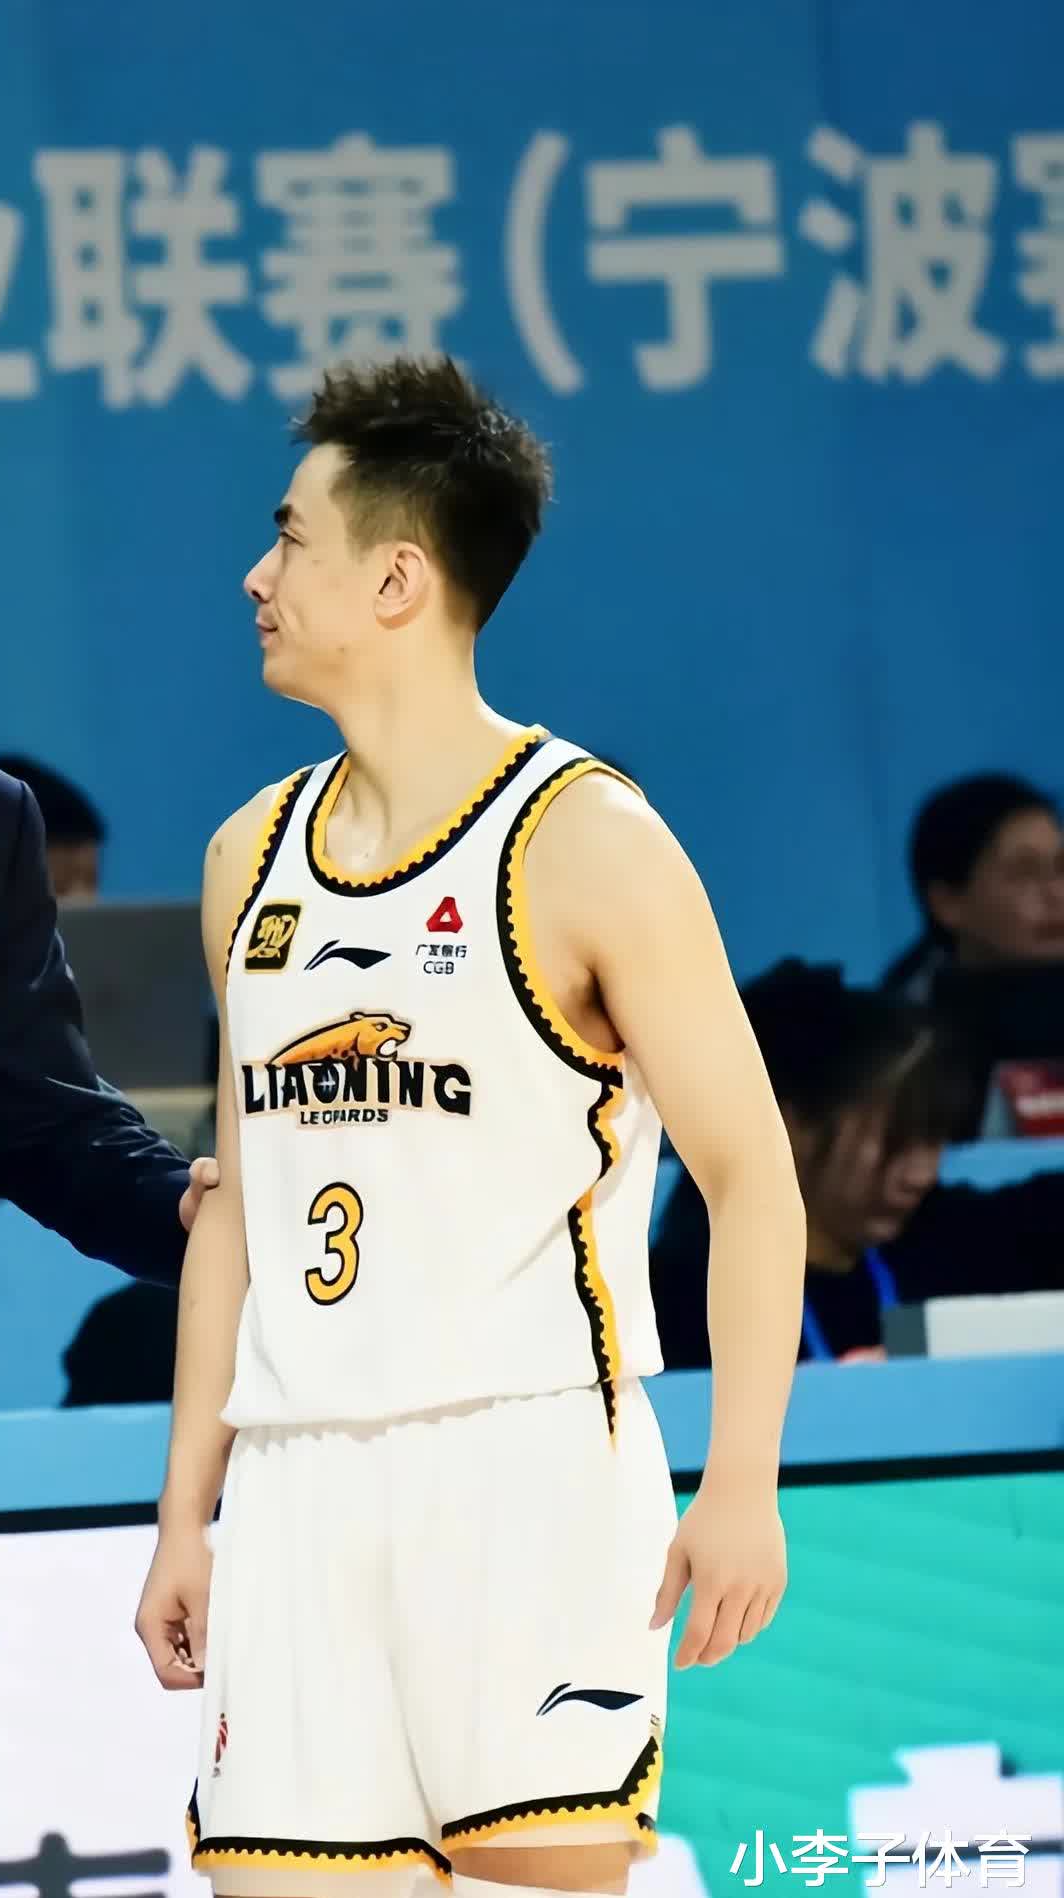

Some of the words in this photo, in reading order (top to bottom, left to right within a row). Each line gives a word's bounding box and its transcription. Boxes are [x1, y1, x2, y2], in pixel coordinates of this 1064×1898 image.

[422, 960, 455, 975] CGB
[242, 1057, 472, 1116] LIAONING
[300, 1108, 389, 1125] LEOPARDS
[304, 1181, 364, 1306] 3
